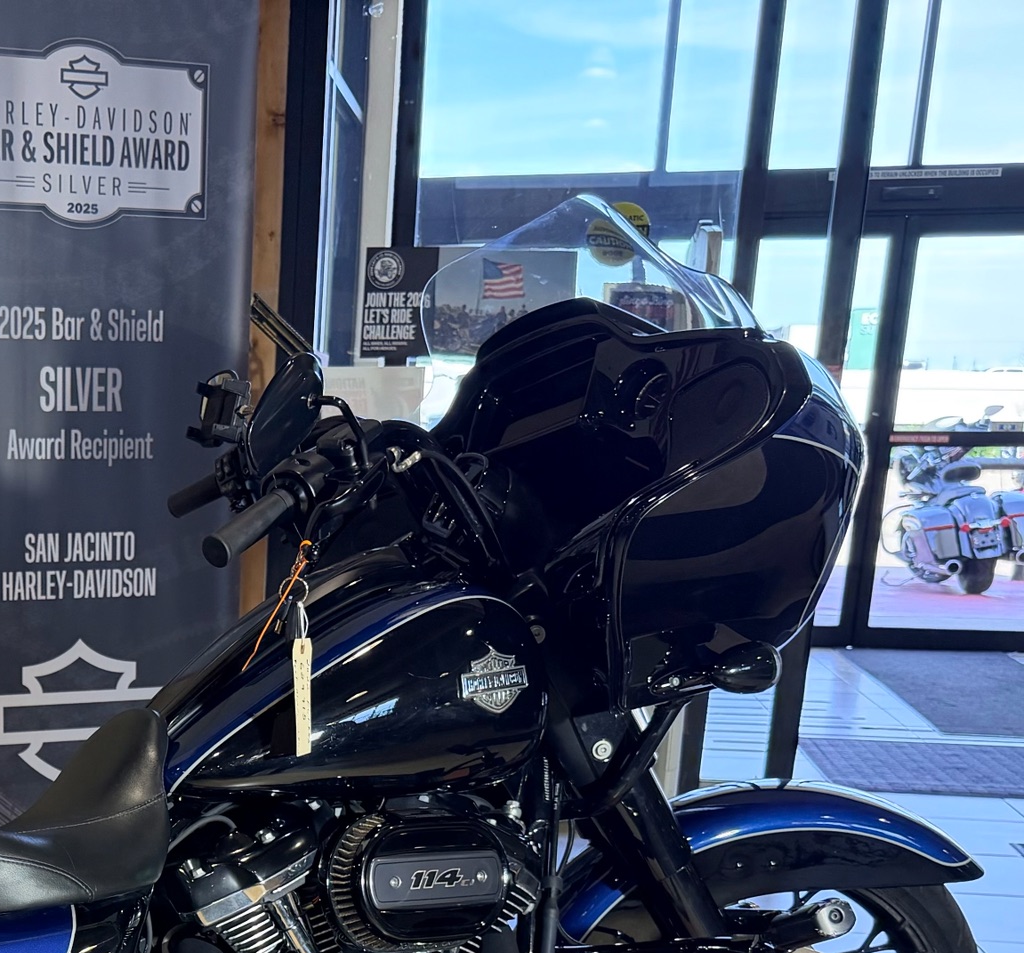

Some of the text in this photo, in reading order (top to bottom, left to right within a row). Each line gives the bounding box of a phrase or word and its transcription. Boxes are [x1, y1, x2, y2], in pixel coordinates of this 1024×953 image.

[21, 130, 37, 163] &
[43, 131, 115, 167] SHIELD
[119, 137, 190, 171] AWARD
[42, 173, 122, 196] SILVER
[67, 202, 99, 215] 2025
[365, 292, 387, 308] JOIN
[387, 292, 406, 308] THE
[52, 307, 85, 341] Bar
[90, 308, 103, 341] &
[107, 308, 164, 343] Shield
[364, 308, 413, 324] LET'S RIDE
[363, 325, 416, 340] CHALLENGE
[39, 365, 123, 412] SILVER
[7, 428, 154, 467] Award Recipient
[24, 531, 135, 564] SAN JACINTO
[2, 567, 157, 601] HARLEY-DAVIDSON
[410, 868, 463, 890] 114
